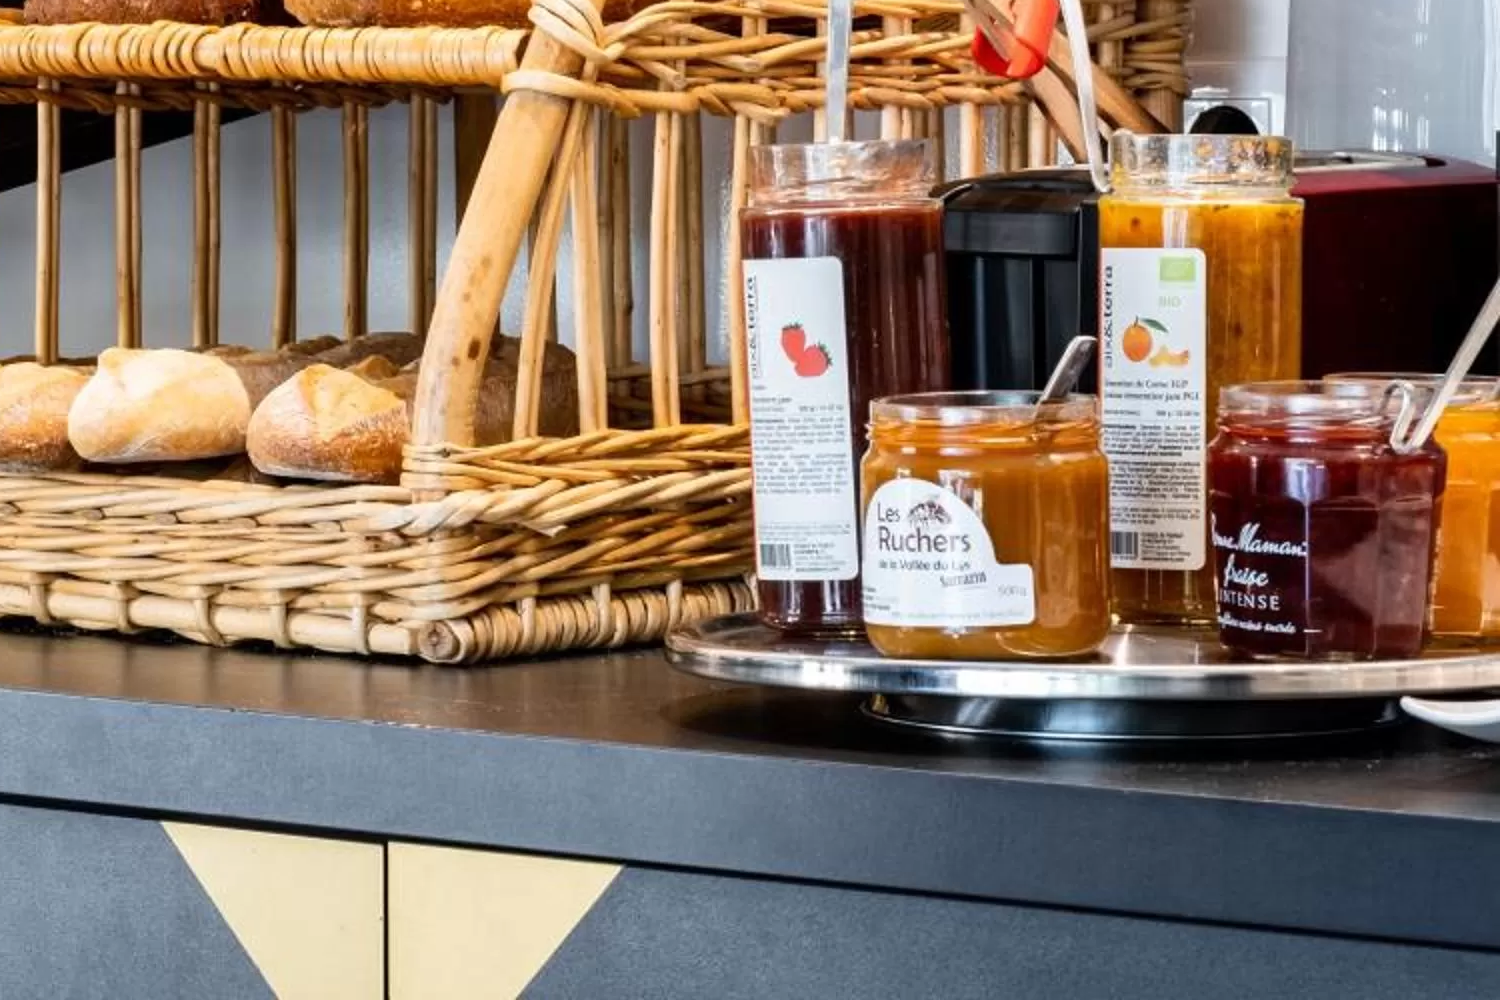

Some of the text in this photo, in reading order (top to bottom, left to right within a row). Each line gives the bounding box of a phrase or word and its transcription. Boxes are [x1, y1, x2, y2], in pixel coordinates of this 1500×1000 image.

[877, 503, 901, 523] Les
[879, 525, 972, 553] Ruchers
[899, 559, 931, 571] Vallée
[933, 559, 949, 571] du
[1219, 587, 1282, 612] INTENSE
